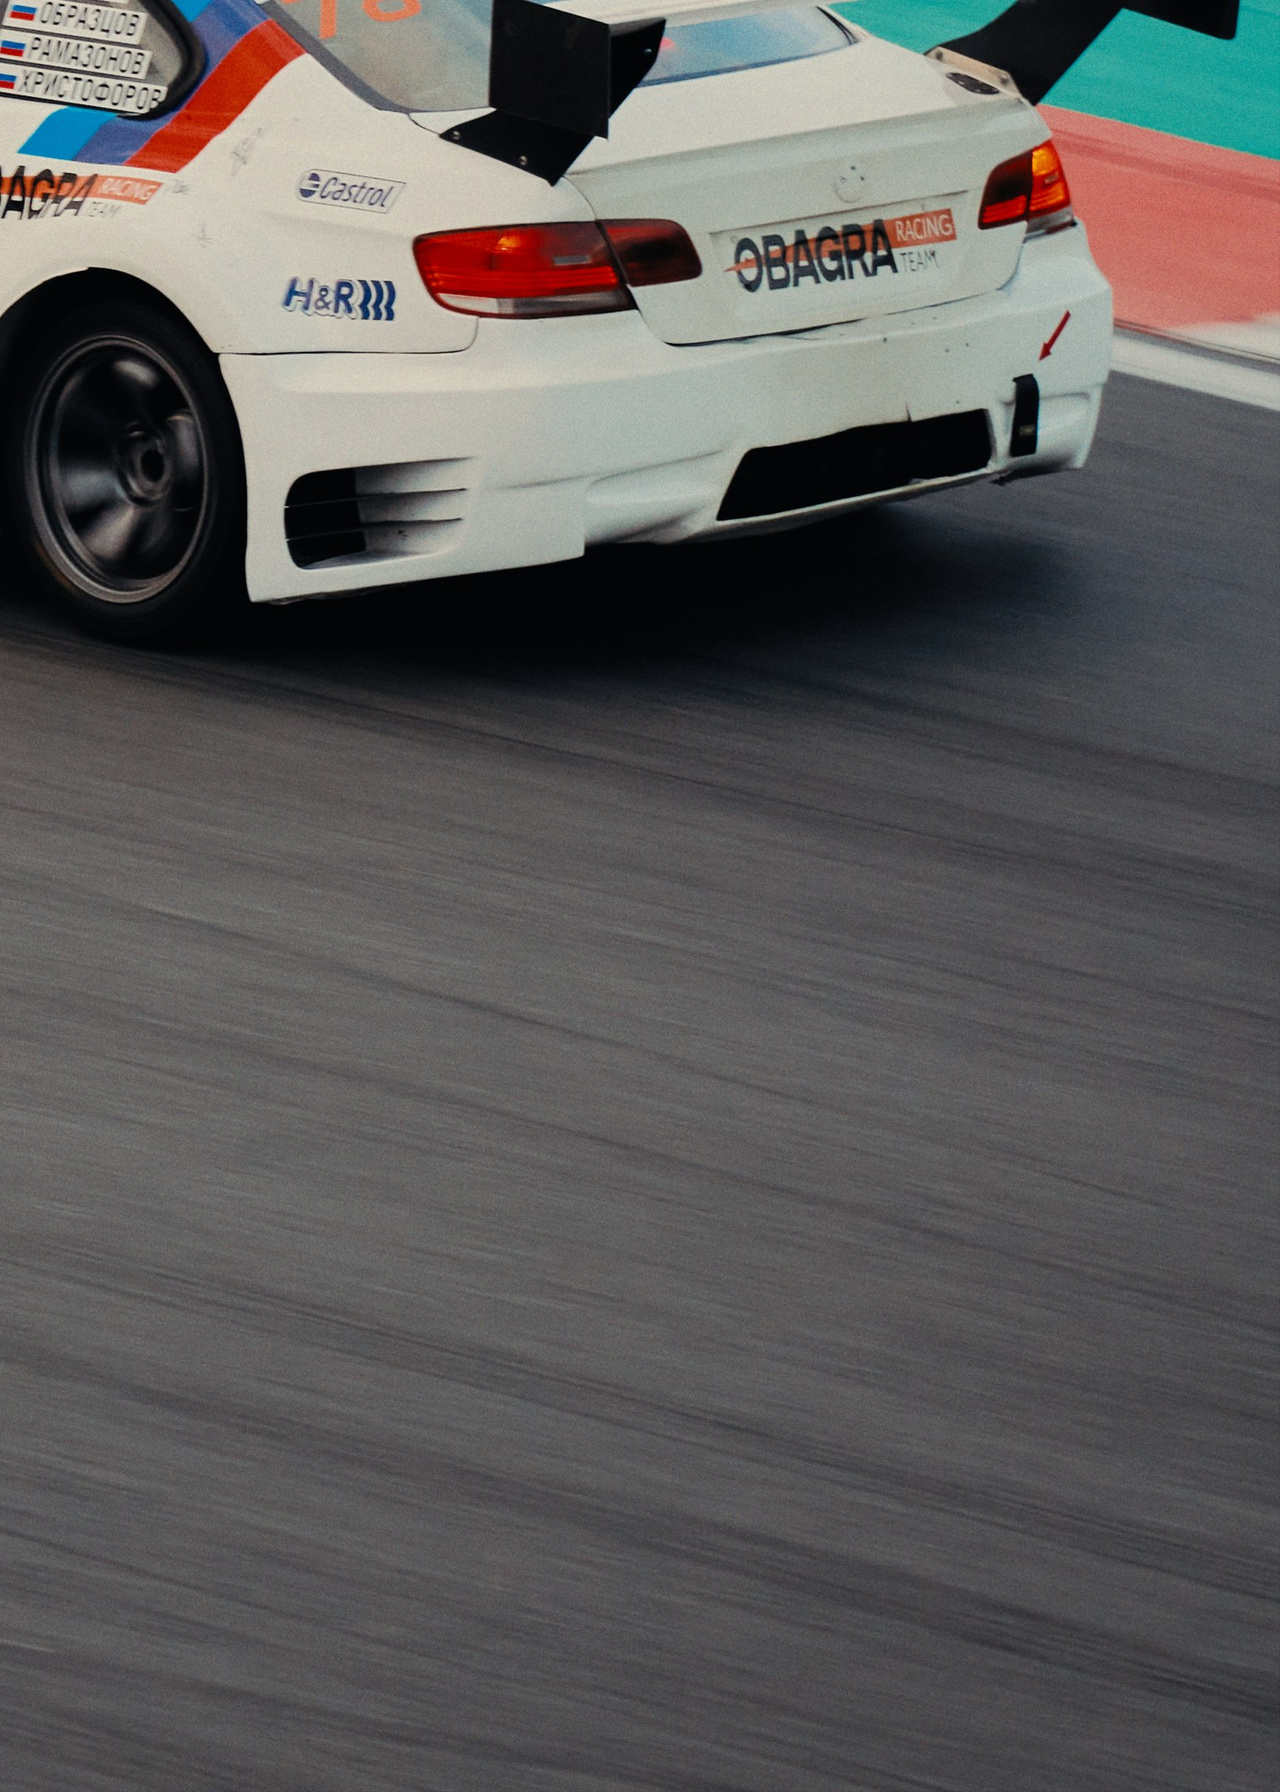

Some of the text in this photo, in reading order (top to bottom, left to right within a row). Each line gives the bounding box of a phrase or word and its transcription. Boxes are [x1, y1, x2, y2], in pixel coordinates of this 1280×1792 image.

[39, 1, 141, 37] ОБРАЗЦОВ
[27, 36, 145, 76] РАМАЗОНОВ
[18, 70, 162, 110] ХРИСТОФОРОВ
[320, 176, 394, 207] Castrol
[734, 214, 954, 293] OBAGRA RACING
[899, 249, 939, 272] TEAM
[283, 277, 355, 314] H&R
